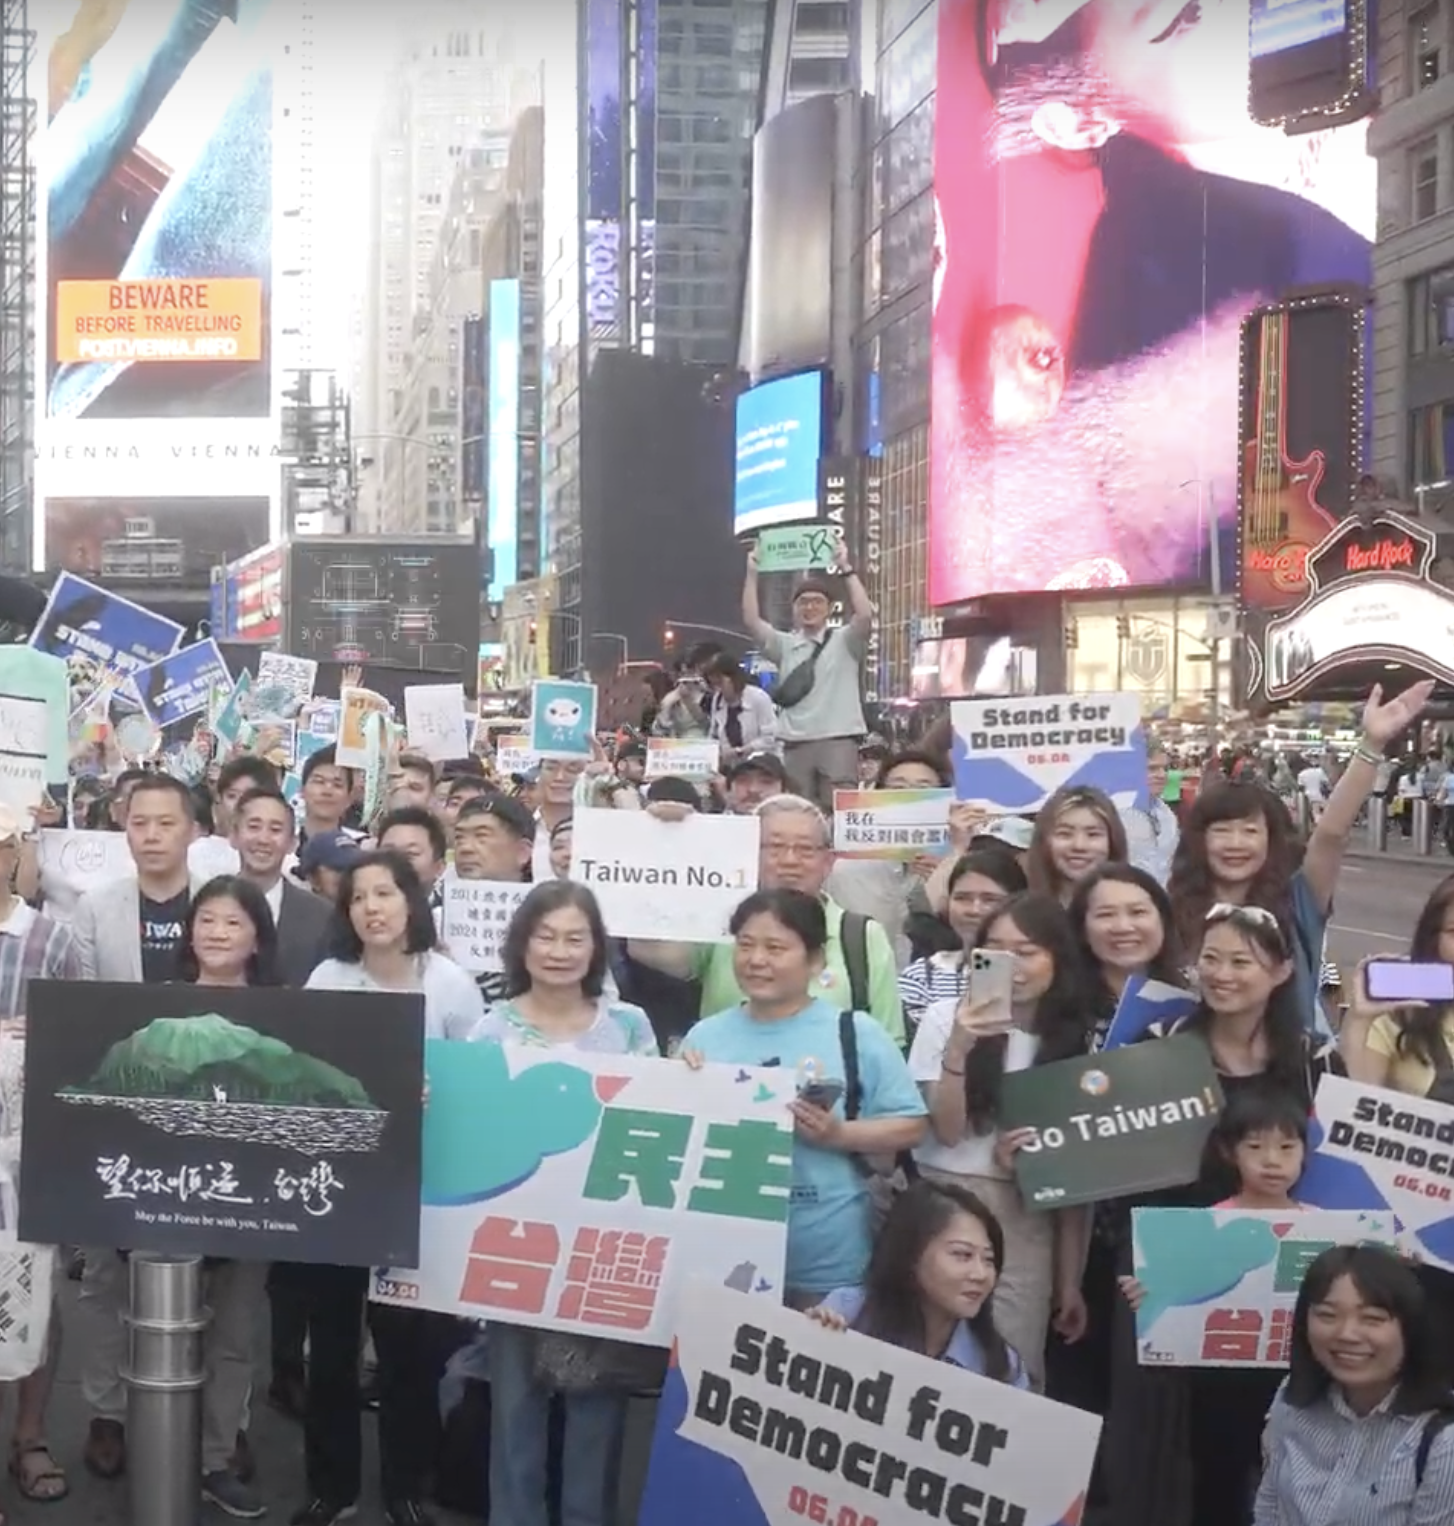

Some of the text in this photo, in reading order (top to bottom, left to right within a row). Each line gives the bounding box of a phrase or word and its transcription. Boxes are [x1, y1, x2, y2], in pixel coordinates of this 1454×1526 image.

[109, 284, 208, 310] BEWARE
[76, 314, 242, 334] BEFORE TRAVELLING
[172, 443, 282, 459] VIENNA
[827, 476, 846, 575] SUARE
[1347, 540, 1414, 572] Hard Rock
[983, 703, 1111, 728] Stand for
[971, 724, 1126, 751] Democracy
[845, 811, 875, 826] 我在
[580, 858, 677, 886] Taiwan
[140, 920, 186, 938] IWA
[1070, 1087, 1218, 1143] Taiwan!
[1353, 1096, 1454, 1150] Stand
[582, 1106, 793, 1223] 民主
[1328, 1119, 1454, 1182] Democ
[134, 1209, 156, 1224] May
[157, 1212, 173, 1223] the
[174, 1212, 200, 1225] Force
[202, 1214, 214, 1226] be
[216, 1215, 237, 1227] with
[459, 1216, 671, 1331] 台灣
[729, 1323, 1008, 1467] Stand for
[694, 1370, 1027, 1526] Democracy
